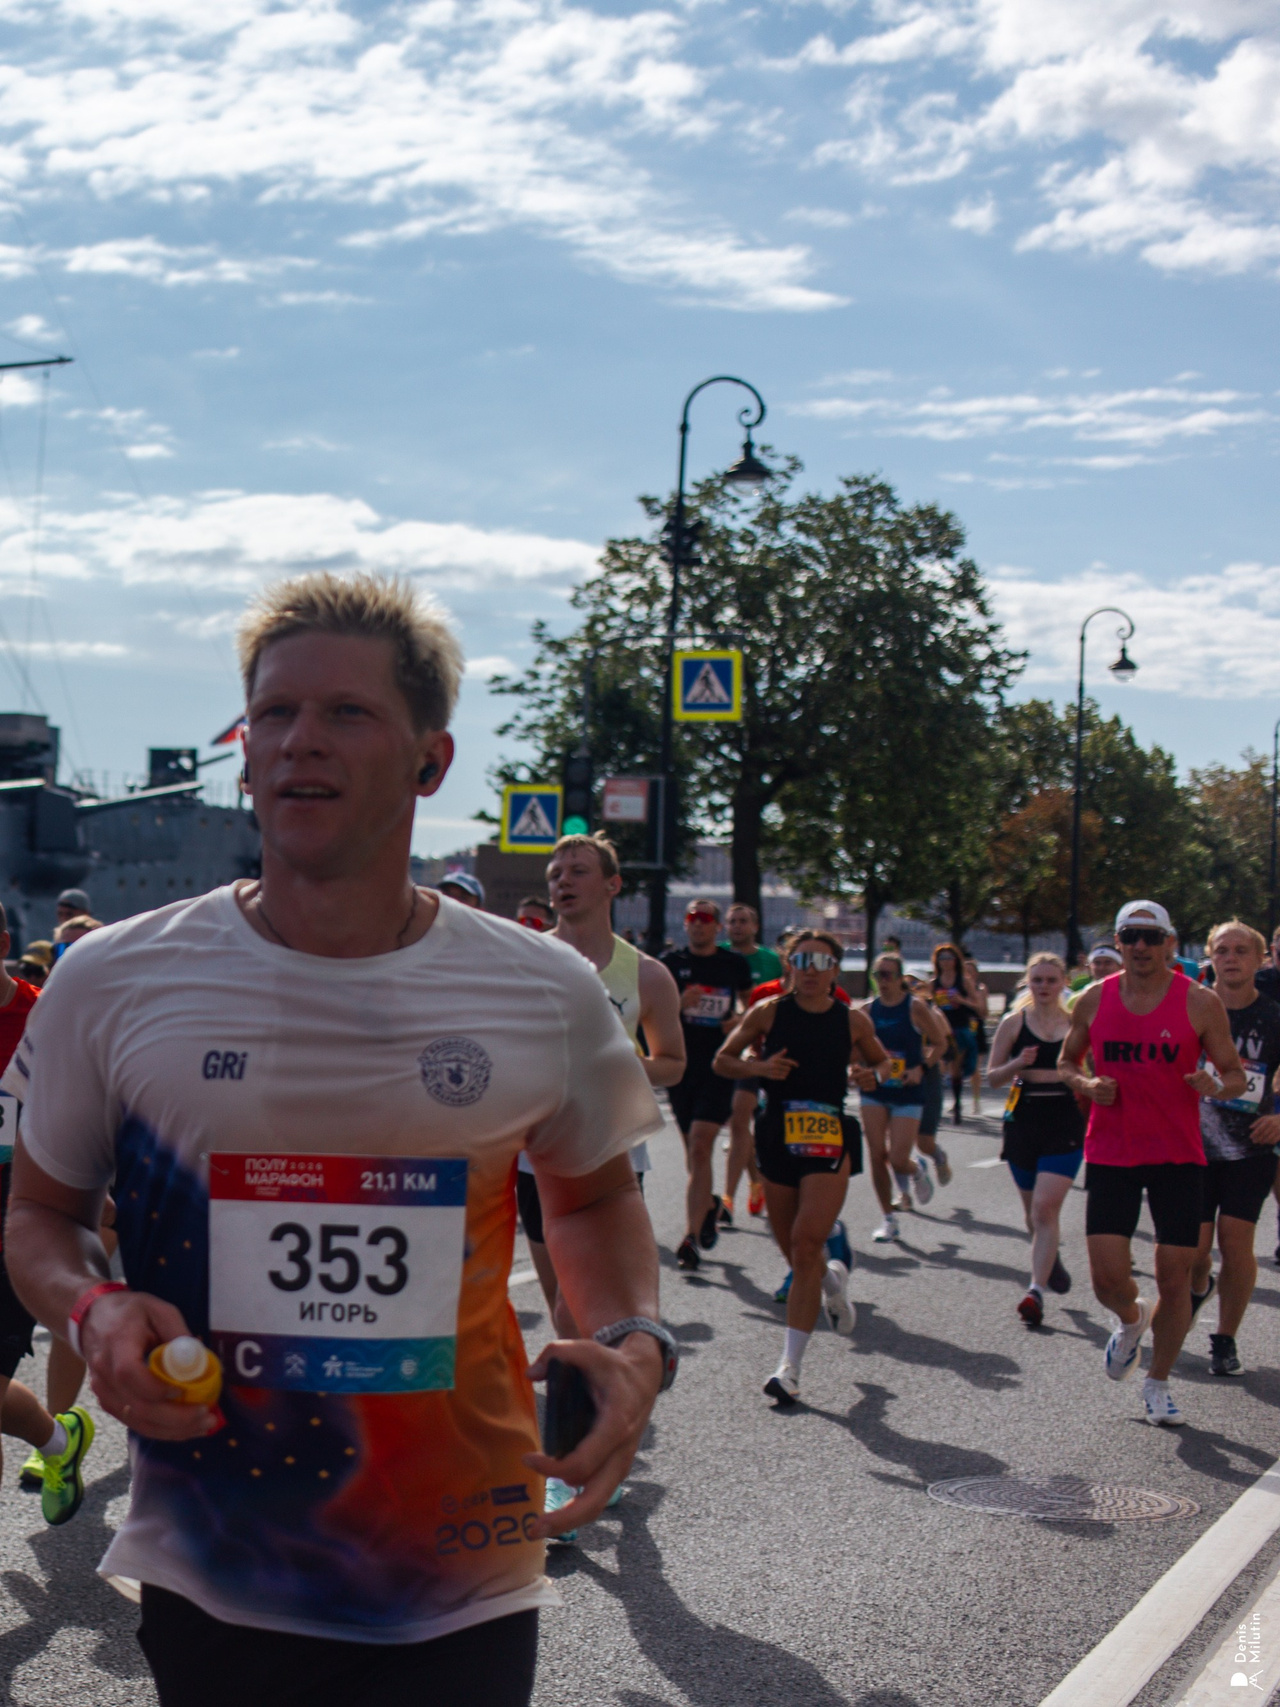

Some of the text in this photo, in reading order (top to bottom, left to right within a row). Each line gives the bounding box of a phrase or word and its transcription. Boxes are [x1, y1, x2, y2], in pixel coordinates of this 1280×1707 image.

[787, 1116, 839, 1135] 11285
[245, 1157, 288, 1172] ПОЛУ
[245, 1171, 324, 1187] МАРАФОН
[361, 1171, 438, 1192] 21,1 КМ
[268, 1221, 409, 1296] 353
[300, 1302, 378, 1323] ИГОРЬ
